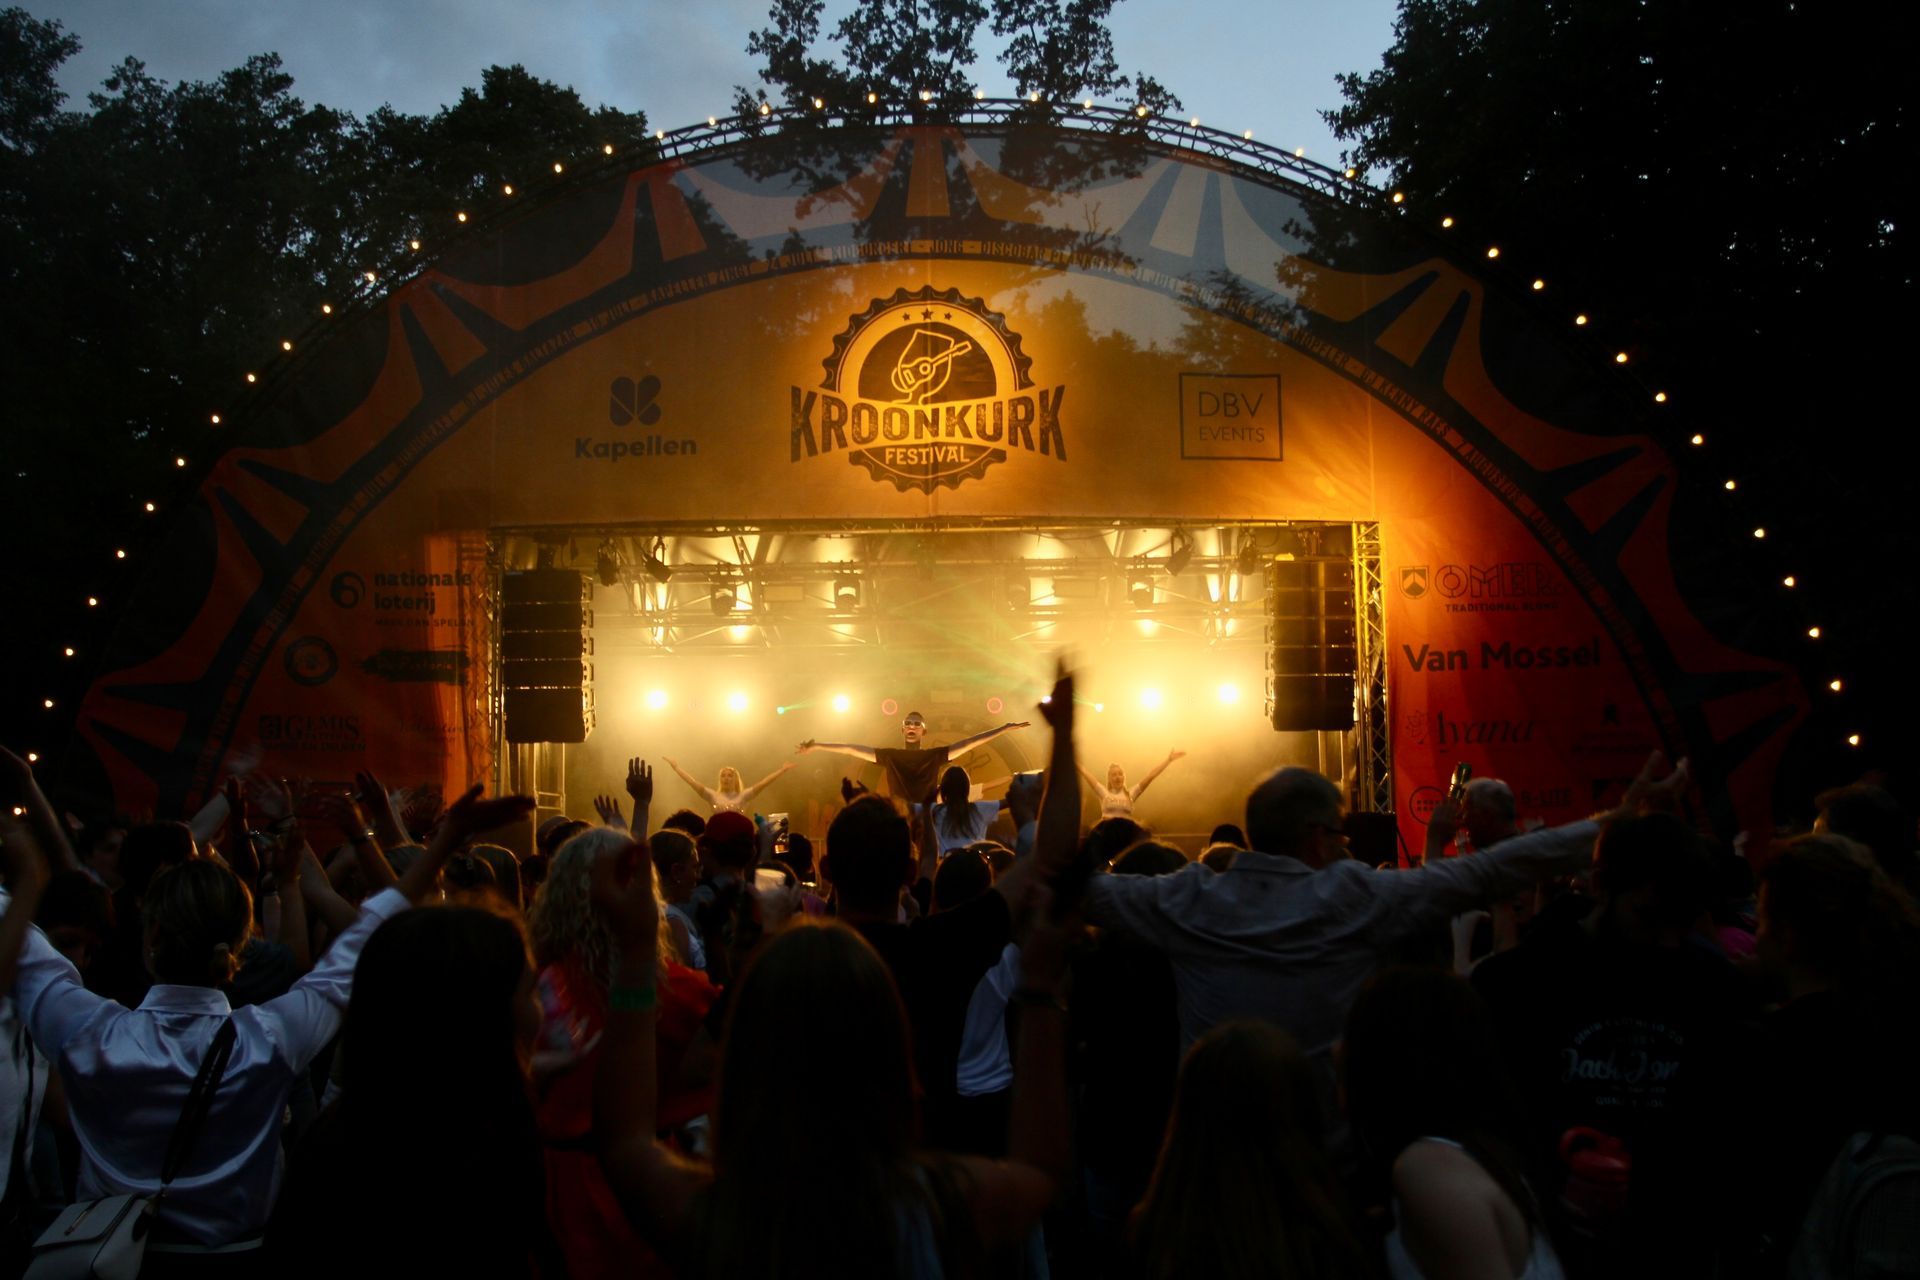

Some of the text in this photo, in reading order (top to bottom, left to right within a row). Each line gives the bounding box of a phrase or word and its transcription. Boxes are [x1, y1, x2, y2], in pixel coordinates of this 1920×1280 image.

[785, 250, 815, 266] JULI
[929, 239, 962, 252] JONG
[980, 240, 1045, 260] DISCOBAR
[1377, 378, 1421, 414] KENNY
[1462, 444, 1524, 503] AUGUSTUS
[1199, 391, 1263, 418] DBV
[790, 385, 1067, 462] KROONKURK
[1199, 427, 1265, 443] EVENTS
[575, 437, 697, 462] Kapellen
[885, 445, 970, 465] FESTIVAL
[374, 571, 471, 586] nationale
[374, 592, 435, 615] loterij
[1445, 602, 1518, 612] TRADITIONAL
[1402, 636, 1600, 672] Van Mossel
[1560, 1046, 1624, 1085] Jack
